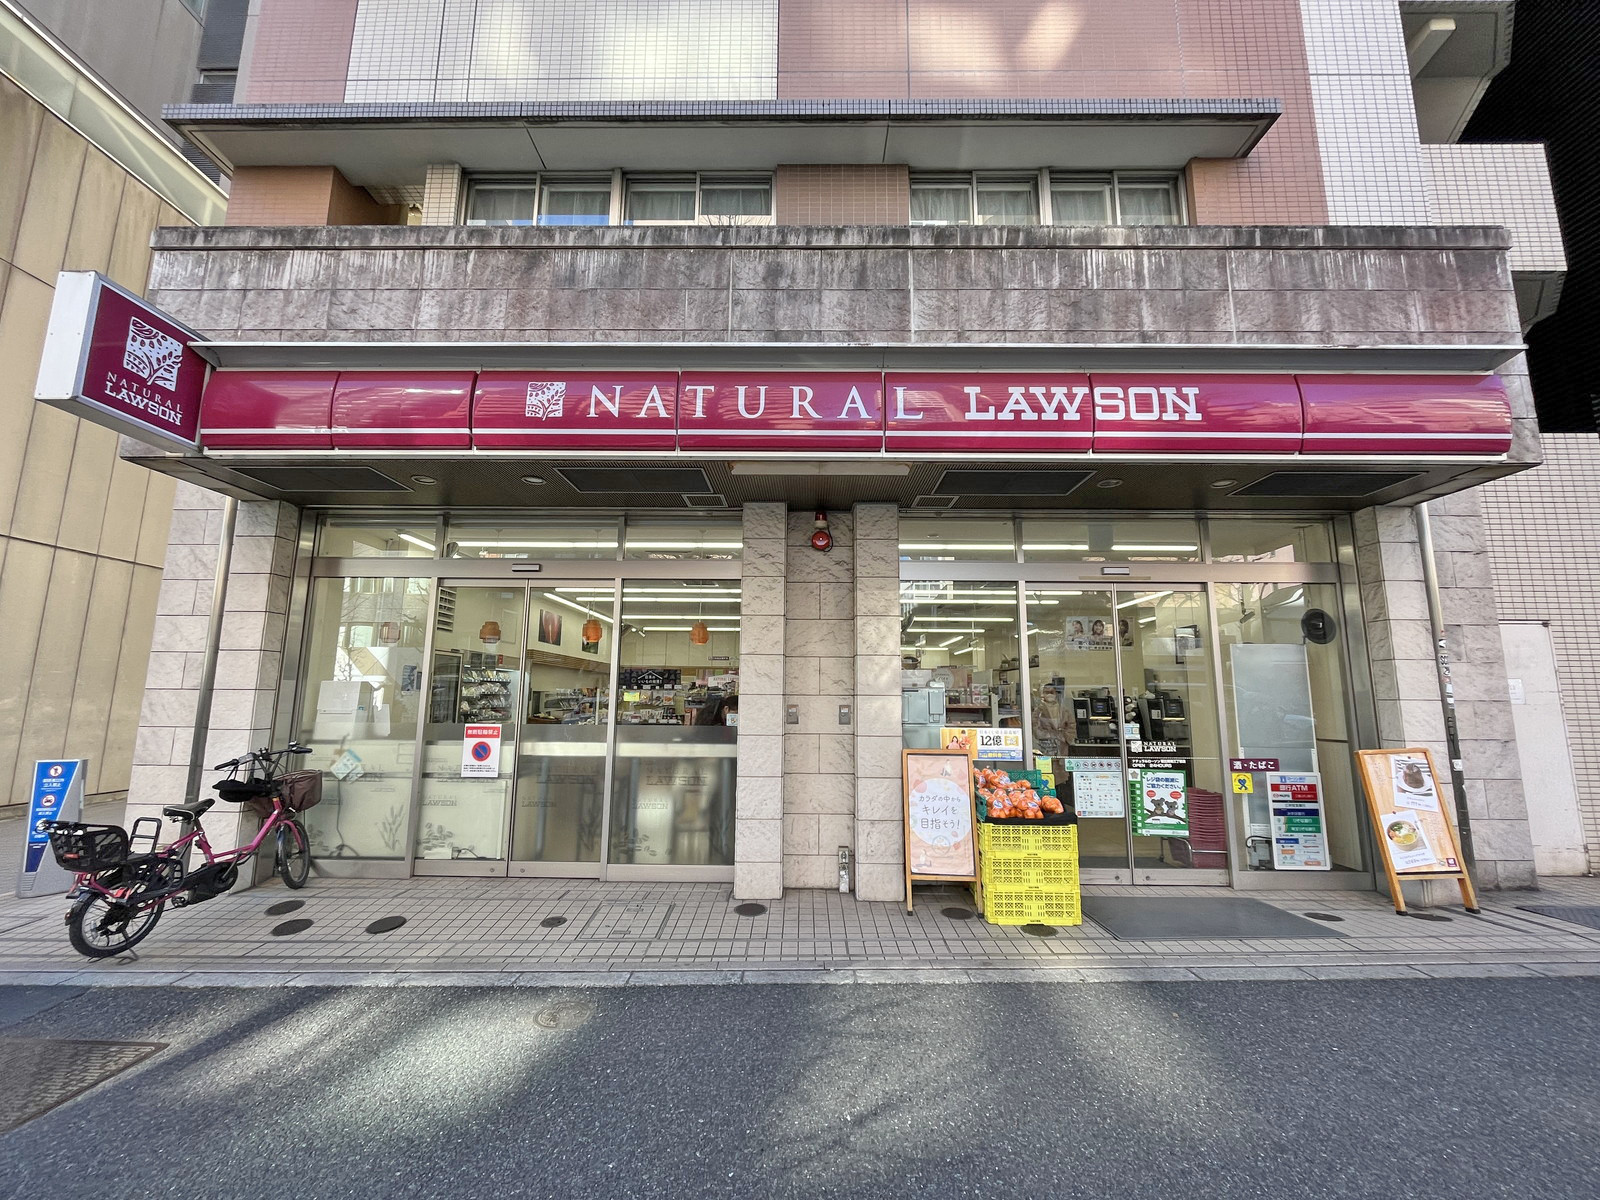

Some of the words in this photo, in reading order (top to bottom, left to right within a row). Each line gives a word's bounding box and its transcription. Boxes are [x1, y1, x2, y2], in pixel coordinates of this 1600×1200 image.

[106, 371, 183, 414] NATURAL
[104, 381, 183, 426] LAWSON
[586, 384, 924, 420] NATURAL
[963, 386, 1203, 421] LAWSON
[1233, 761, 1275, 769] 酒・たばこ
[919, 794, 961, 803] カラダの中から
[922, 804, 958, 816] キレイを
[920, 817, 961, 830] 目指そう!
